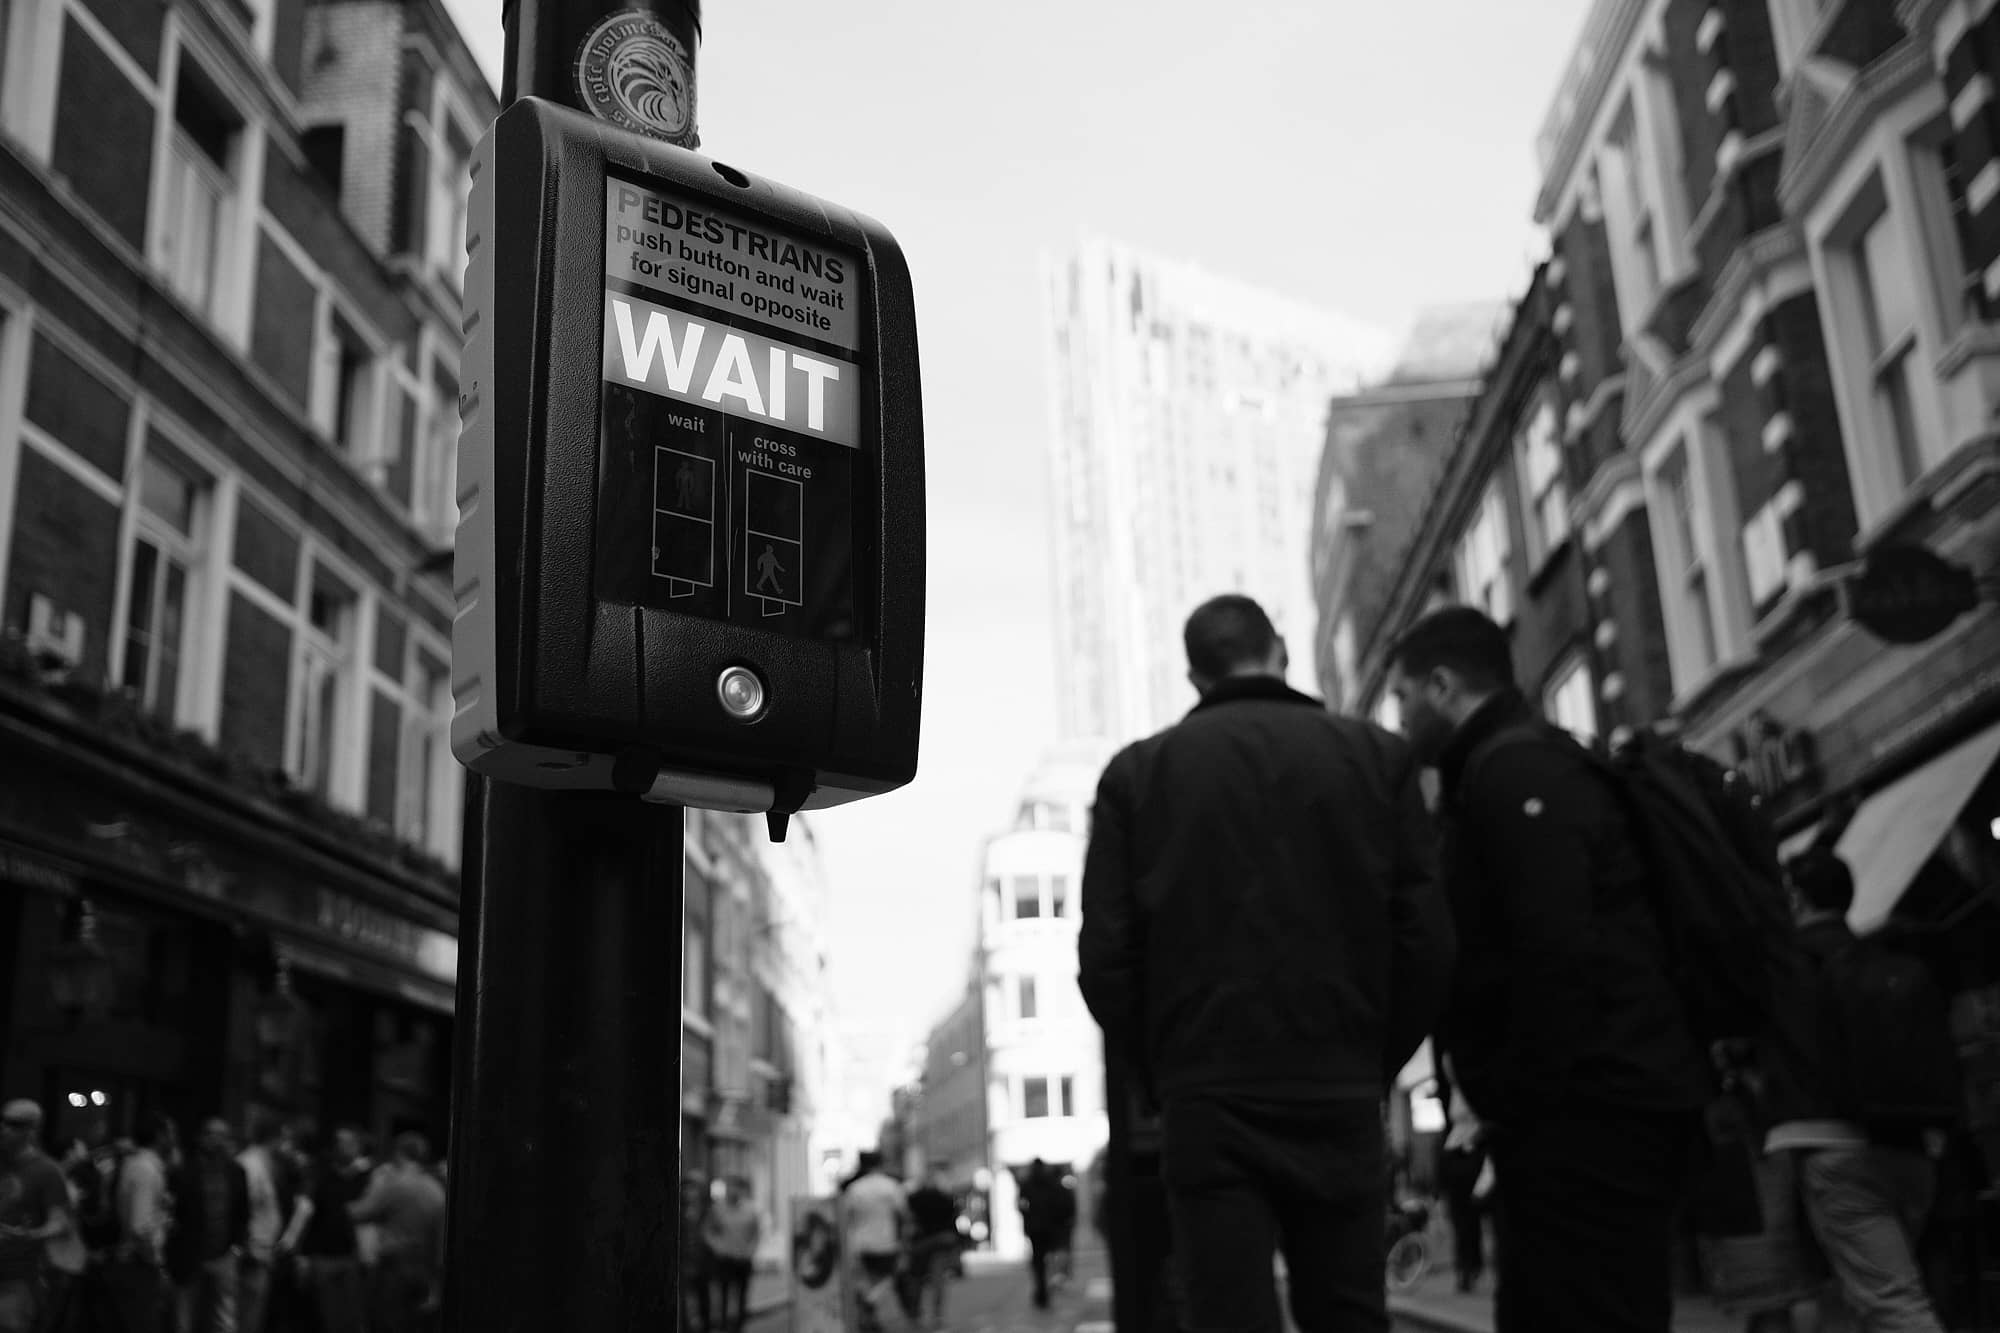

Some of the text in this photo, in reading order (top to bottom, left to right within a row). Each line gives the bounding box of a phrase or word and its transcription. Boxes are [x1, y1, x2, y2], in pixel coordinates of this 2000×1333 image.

[616, 187, 845, 284] PEDESTRIANS
[616, 223, 845, 311] push button and wait
[630, 251, 832, 332] for signal opposite
[612, 299, 840, 432] WAIT
[668, 413, 705, 433] wait
[753, 436, 797, 457] cross
[737, 449, 813, 479] with care
